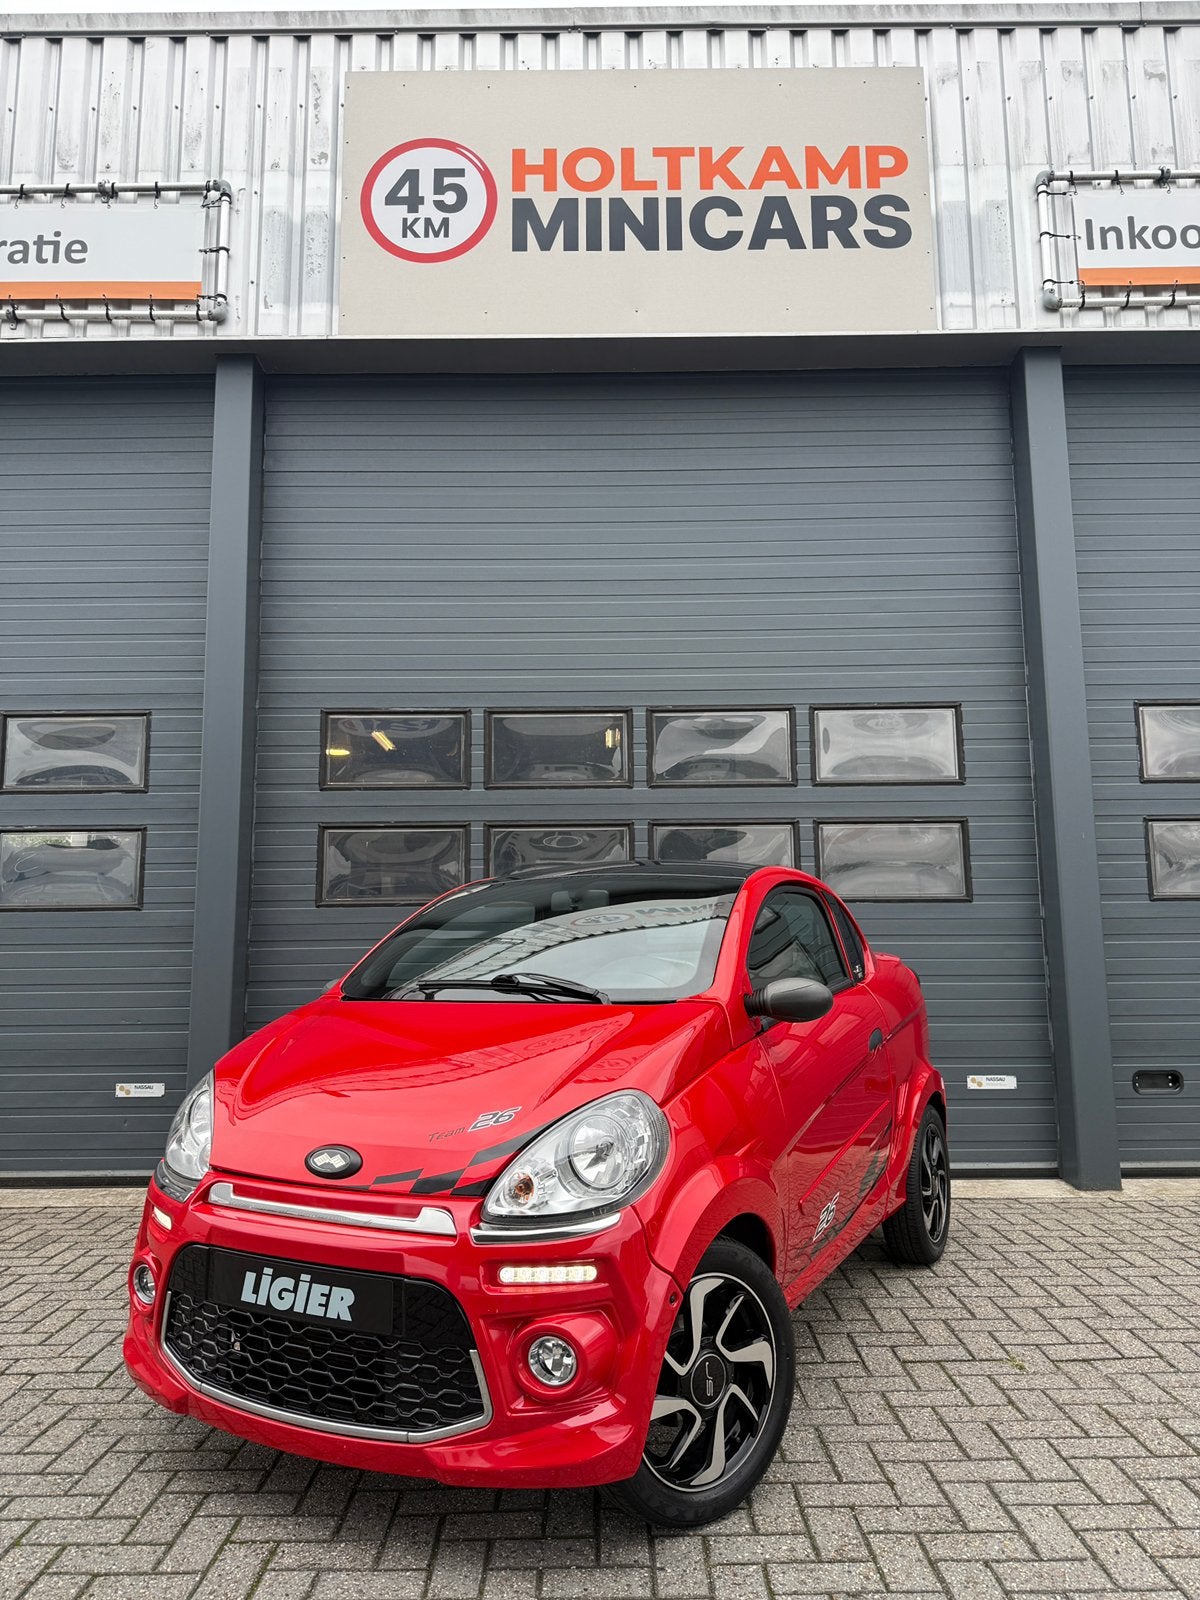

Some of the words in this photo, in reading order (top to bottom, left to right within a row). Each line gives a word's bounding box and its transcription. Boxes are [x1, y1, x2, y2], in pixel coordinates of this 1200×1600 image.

[384, 167, 468, 214] 45
[511, 145, 909, 193] HOLTKAMP
[401, 216, 450, 239] KM
[511, 194, 912, 253] MINICARS
[1084, 215, 1200, 251] Inkoo
[428, 1126, 466, 1143] Team
[467, 1105, 523, 1132] 26
[812, 1191, 841, 1242] 26
